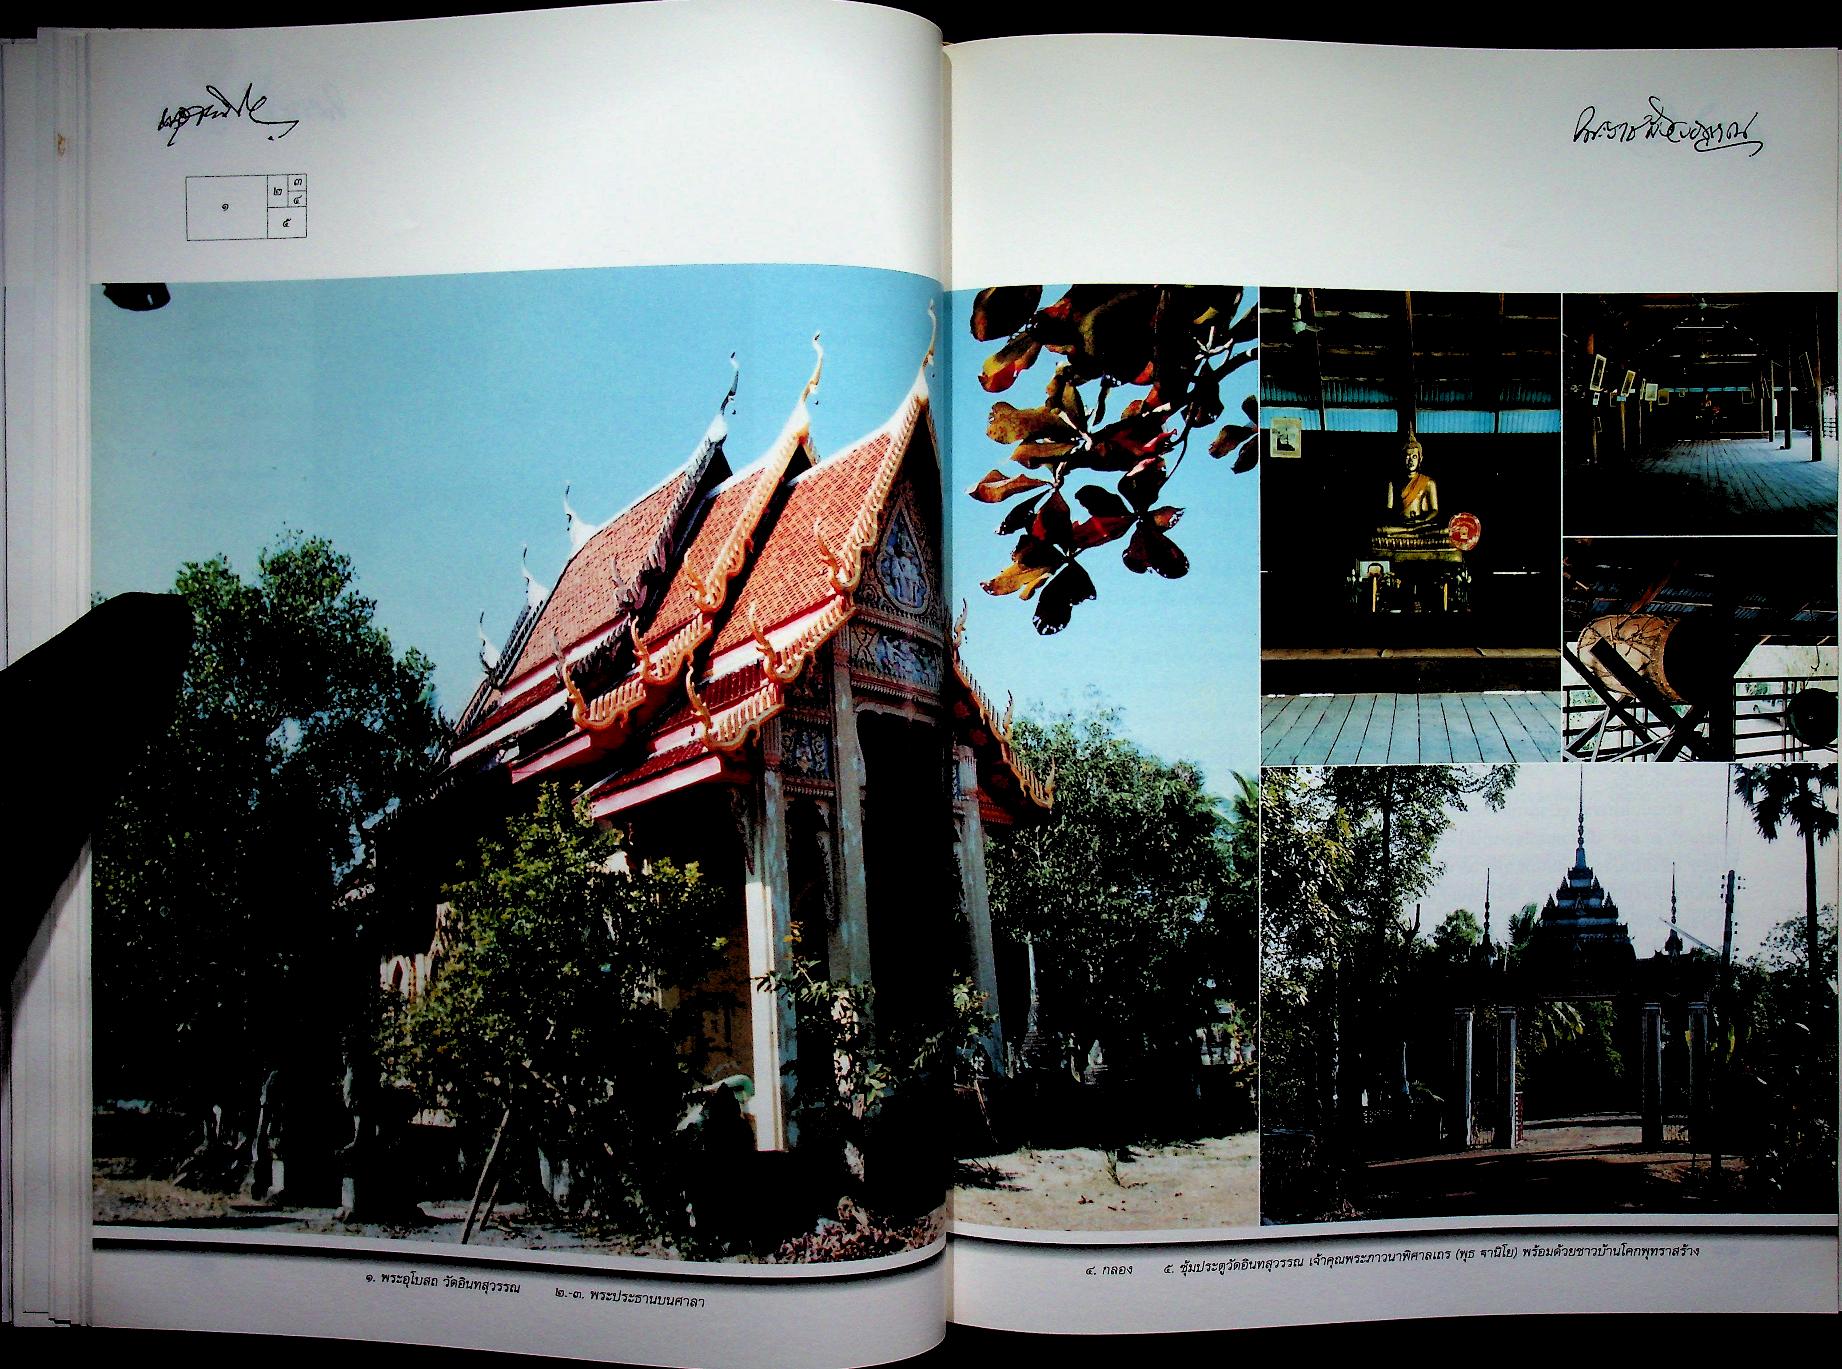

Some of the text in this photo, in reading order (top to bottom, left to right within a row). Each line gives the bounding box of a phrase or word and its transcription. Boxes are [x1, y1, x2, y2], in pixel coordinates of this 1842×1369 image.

[221, 203, 230, 212] ๑
[1102, 1265, 1133, 1275] กลอง
[365, 1271, 521, 1294] ๑. พระอุโบสถ วัดอินทสุวรรณ
[590, 1289, 705, 1308] พระประธานบนศาลา
